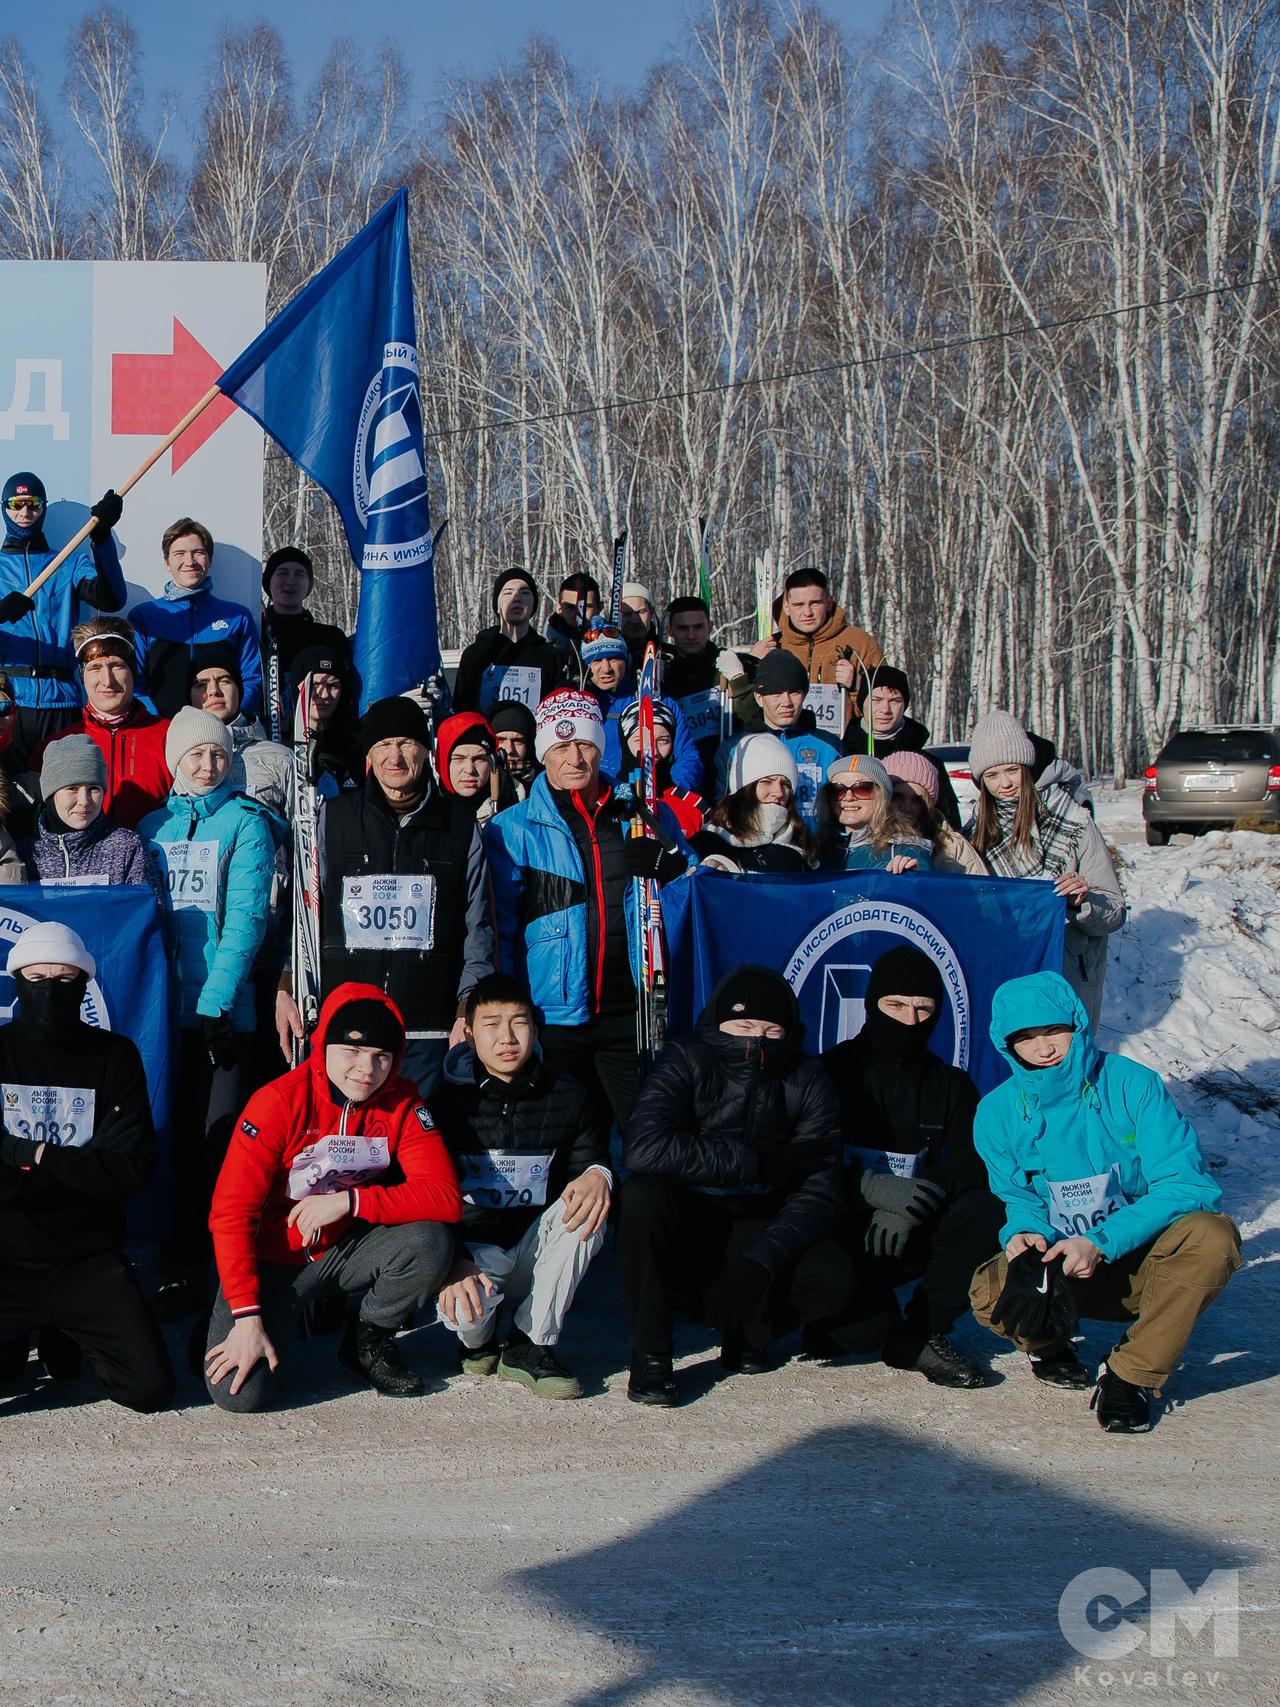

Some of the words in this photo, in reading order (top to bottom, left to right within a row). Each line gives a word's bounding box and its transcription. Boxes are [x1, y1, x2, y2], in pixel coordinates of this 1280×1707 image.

[540, 701, 591, 716] FORWARD
[358, 905, 417, 930] 3050
[786, 958, 805, 986] ЫЙ
[802, 909, 948, 960] ИССЛЕДОВАТЕЛЬСКИЙ
[31, 1106, 57, 1114] 2024
[18, 1119, 77, 1146] 3082
[328, 1139, 356, 1147] ЛЫЖНЯ
[1060, 1181, 1091, 1192] ЛЫЖНЯ
[1061, 1188, 1092, 1199] РОССИИ
[1064, 1197, 1096, 1208] 2024
